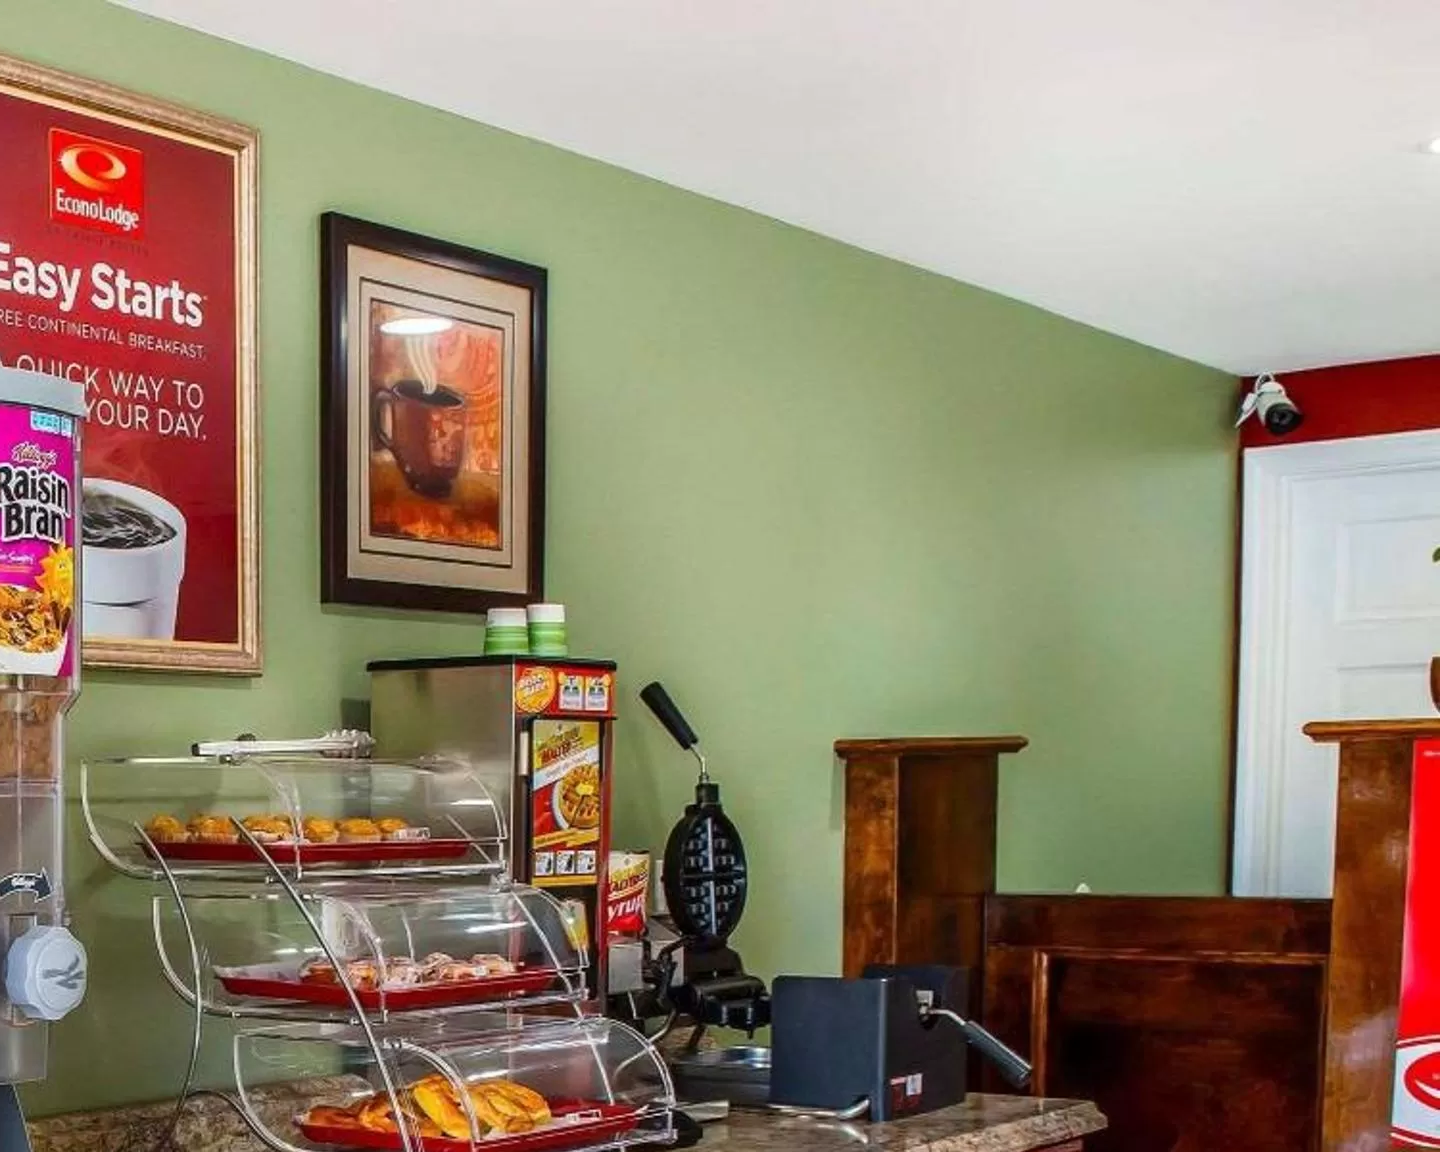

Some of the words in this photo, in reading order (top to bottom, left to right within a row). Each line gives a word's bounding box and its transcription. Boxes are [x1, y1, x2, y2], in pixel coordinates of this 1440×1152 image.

[56, 188, 140, 232] EconoLodge
[90, 261, 203, 328] Starts
[28, 314, 124, 345] CONTINENTAL
[109, 368, 164, 402] WAY
[172, 380, 204, 410] TO
[85, 398, 149, 431] YOUR
[159, 408, 207, 440] DAY.
[3, 502, 64, 541] Bran
